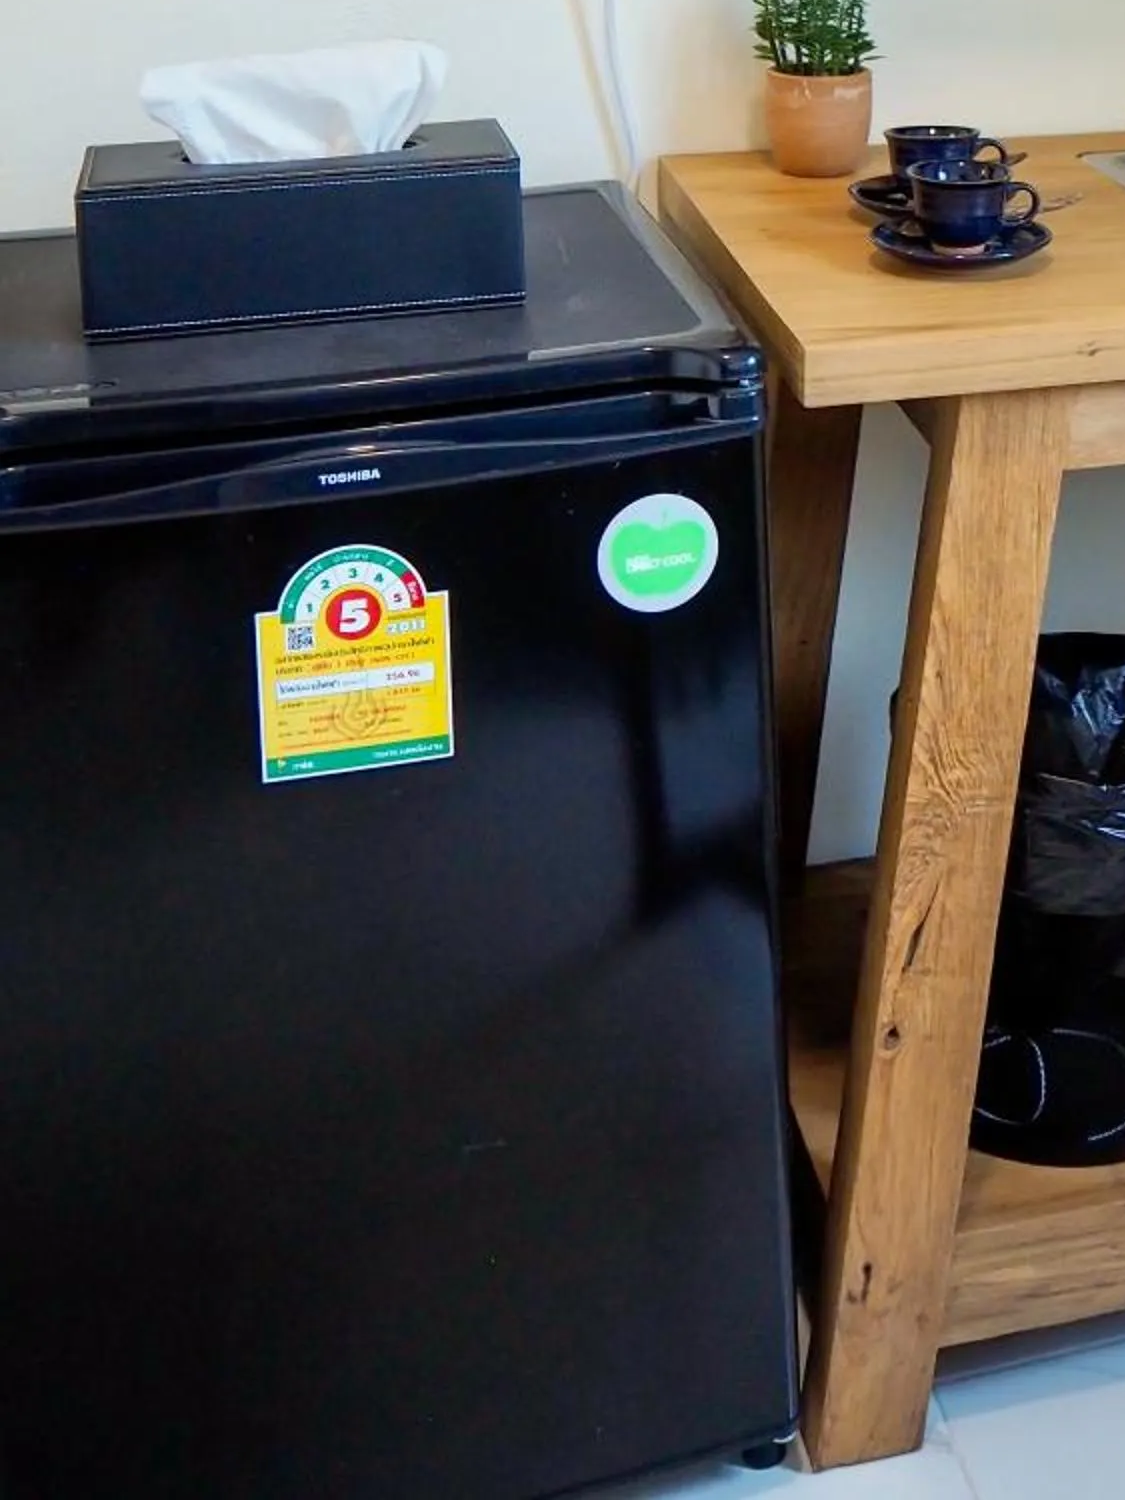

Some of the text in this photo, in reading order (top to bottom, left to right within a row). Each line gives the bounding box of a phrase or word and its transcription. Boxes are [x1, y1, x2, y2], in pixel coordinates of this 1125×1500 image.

[318, 468, 381, 486] TOSHIBA
[347, 568, 358, 579] 3
[374, 573, 384, 583] 4
[321, 580, 331, 590] 2
[393, 593, 403, 603] 5
[305, 602, 313, 613] 1
[339, 597, 372, 634] 5
